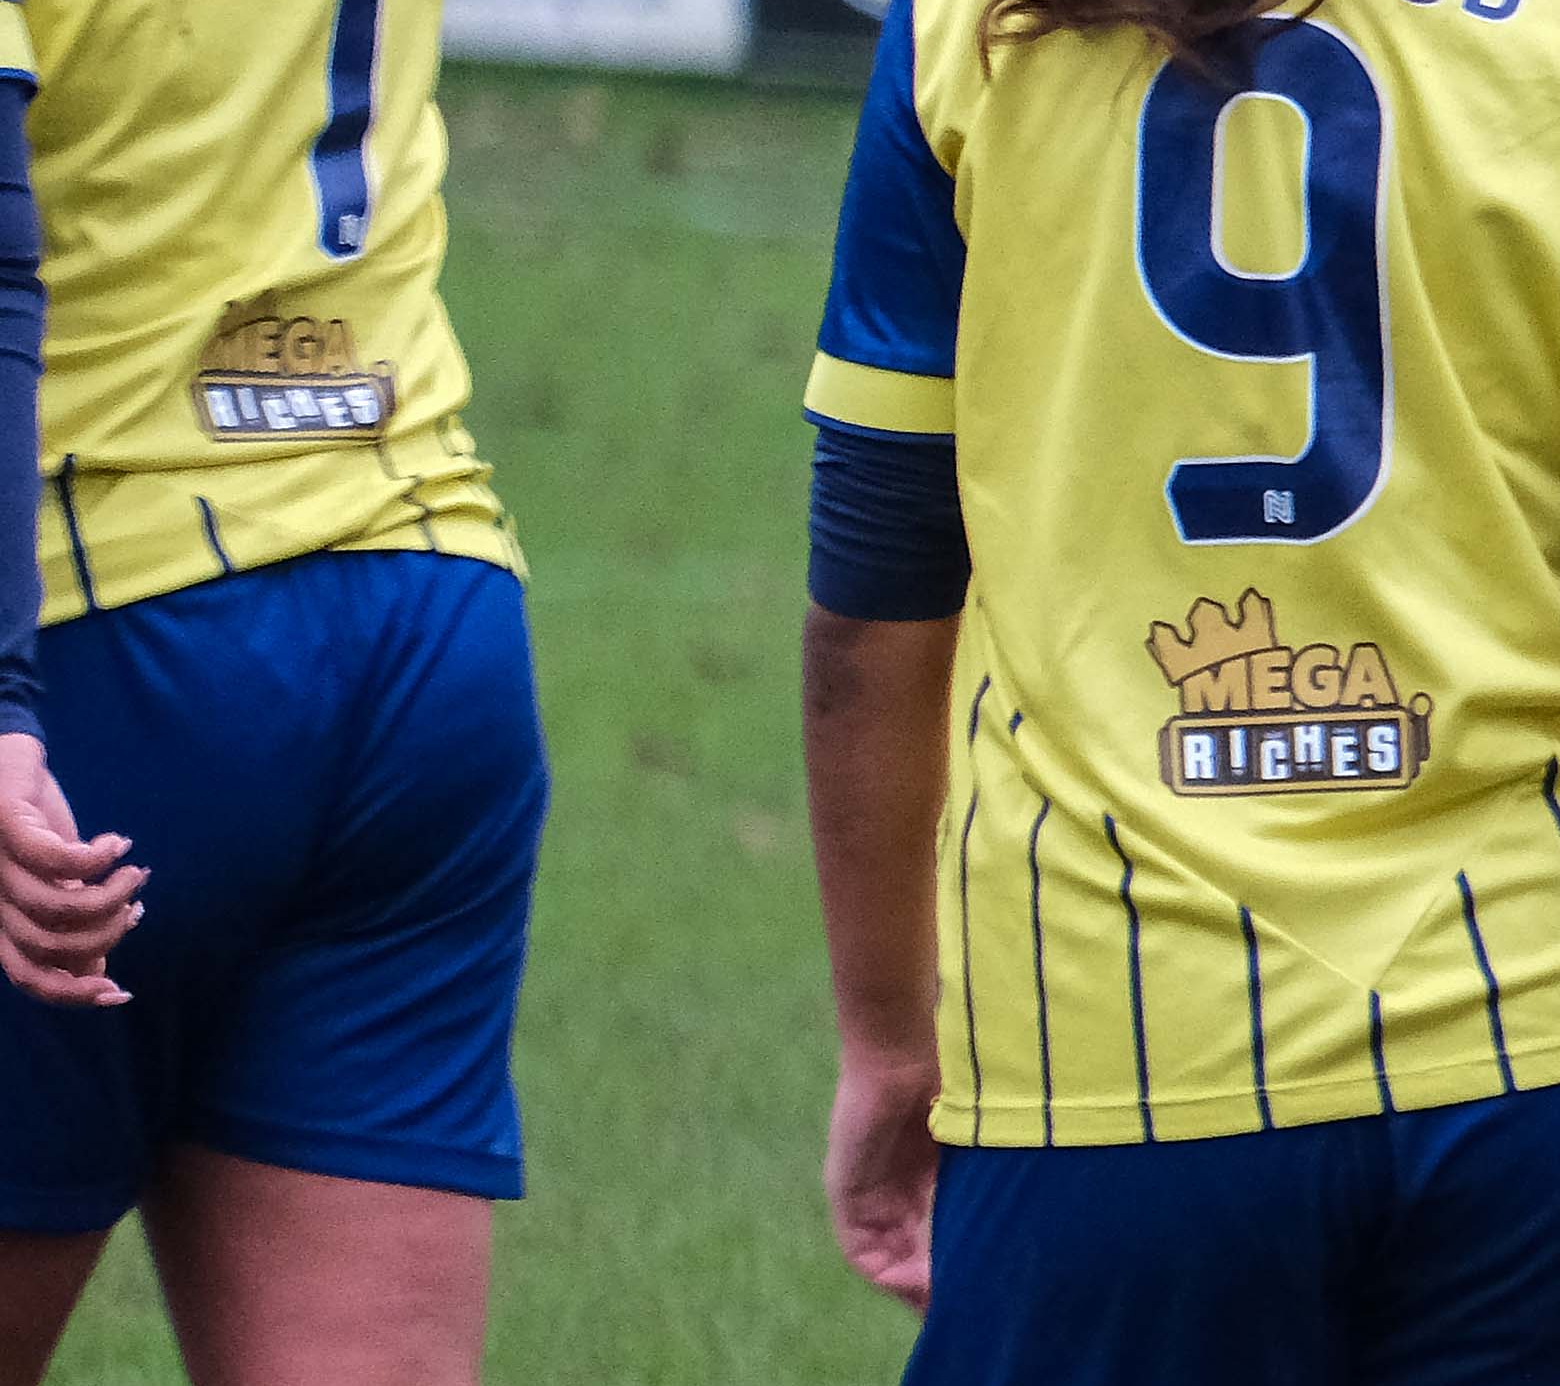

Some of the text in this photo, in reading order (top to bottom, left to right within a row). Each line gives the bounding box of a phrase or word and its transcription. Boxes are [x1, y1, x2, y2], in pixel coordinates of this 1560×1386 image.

[1134, 14, 1394, 545] 9
[1181, 642, 1400, 713] MEGA
[1182, 723, 1400, 780] RICHES
